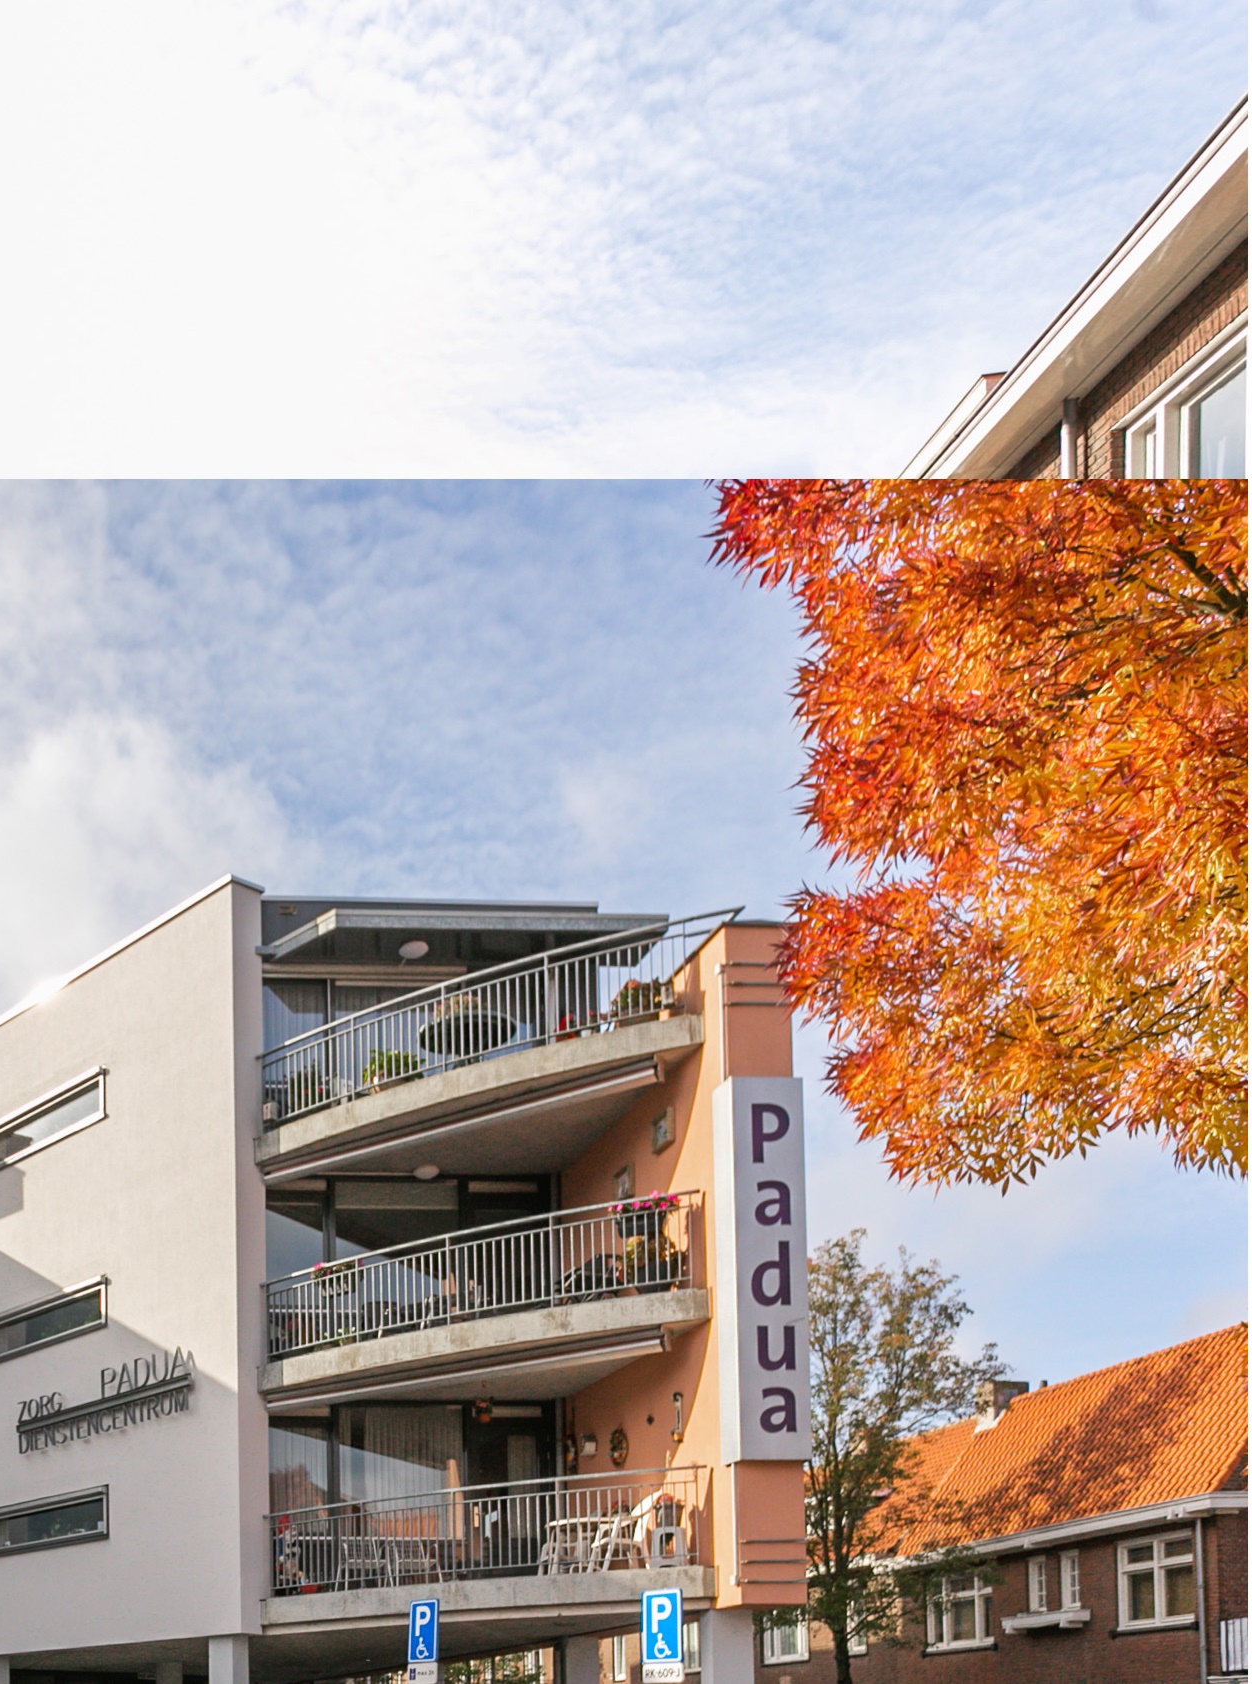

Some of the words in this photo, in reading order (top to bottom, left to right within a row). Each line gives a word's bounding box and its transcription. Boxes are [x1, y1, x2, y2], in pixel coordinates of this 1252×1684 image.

[750, 1102, 798, 1434] Padua
[17, 1391, 63, 1424] ZORG
[100, 1346, 187, 1399] PADUA
[18, 1389, 190, 1455] DIENSTENCENTRUM
[414, 1605, 431, 1637] P
[650, 1596, 673, 1634] P
